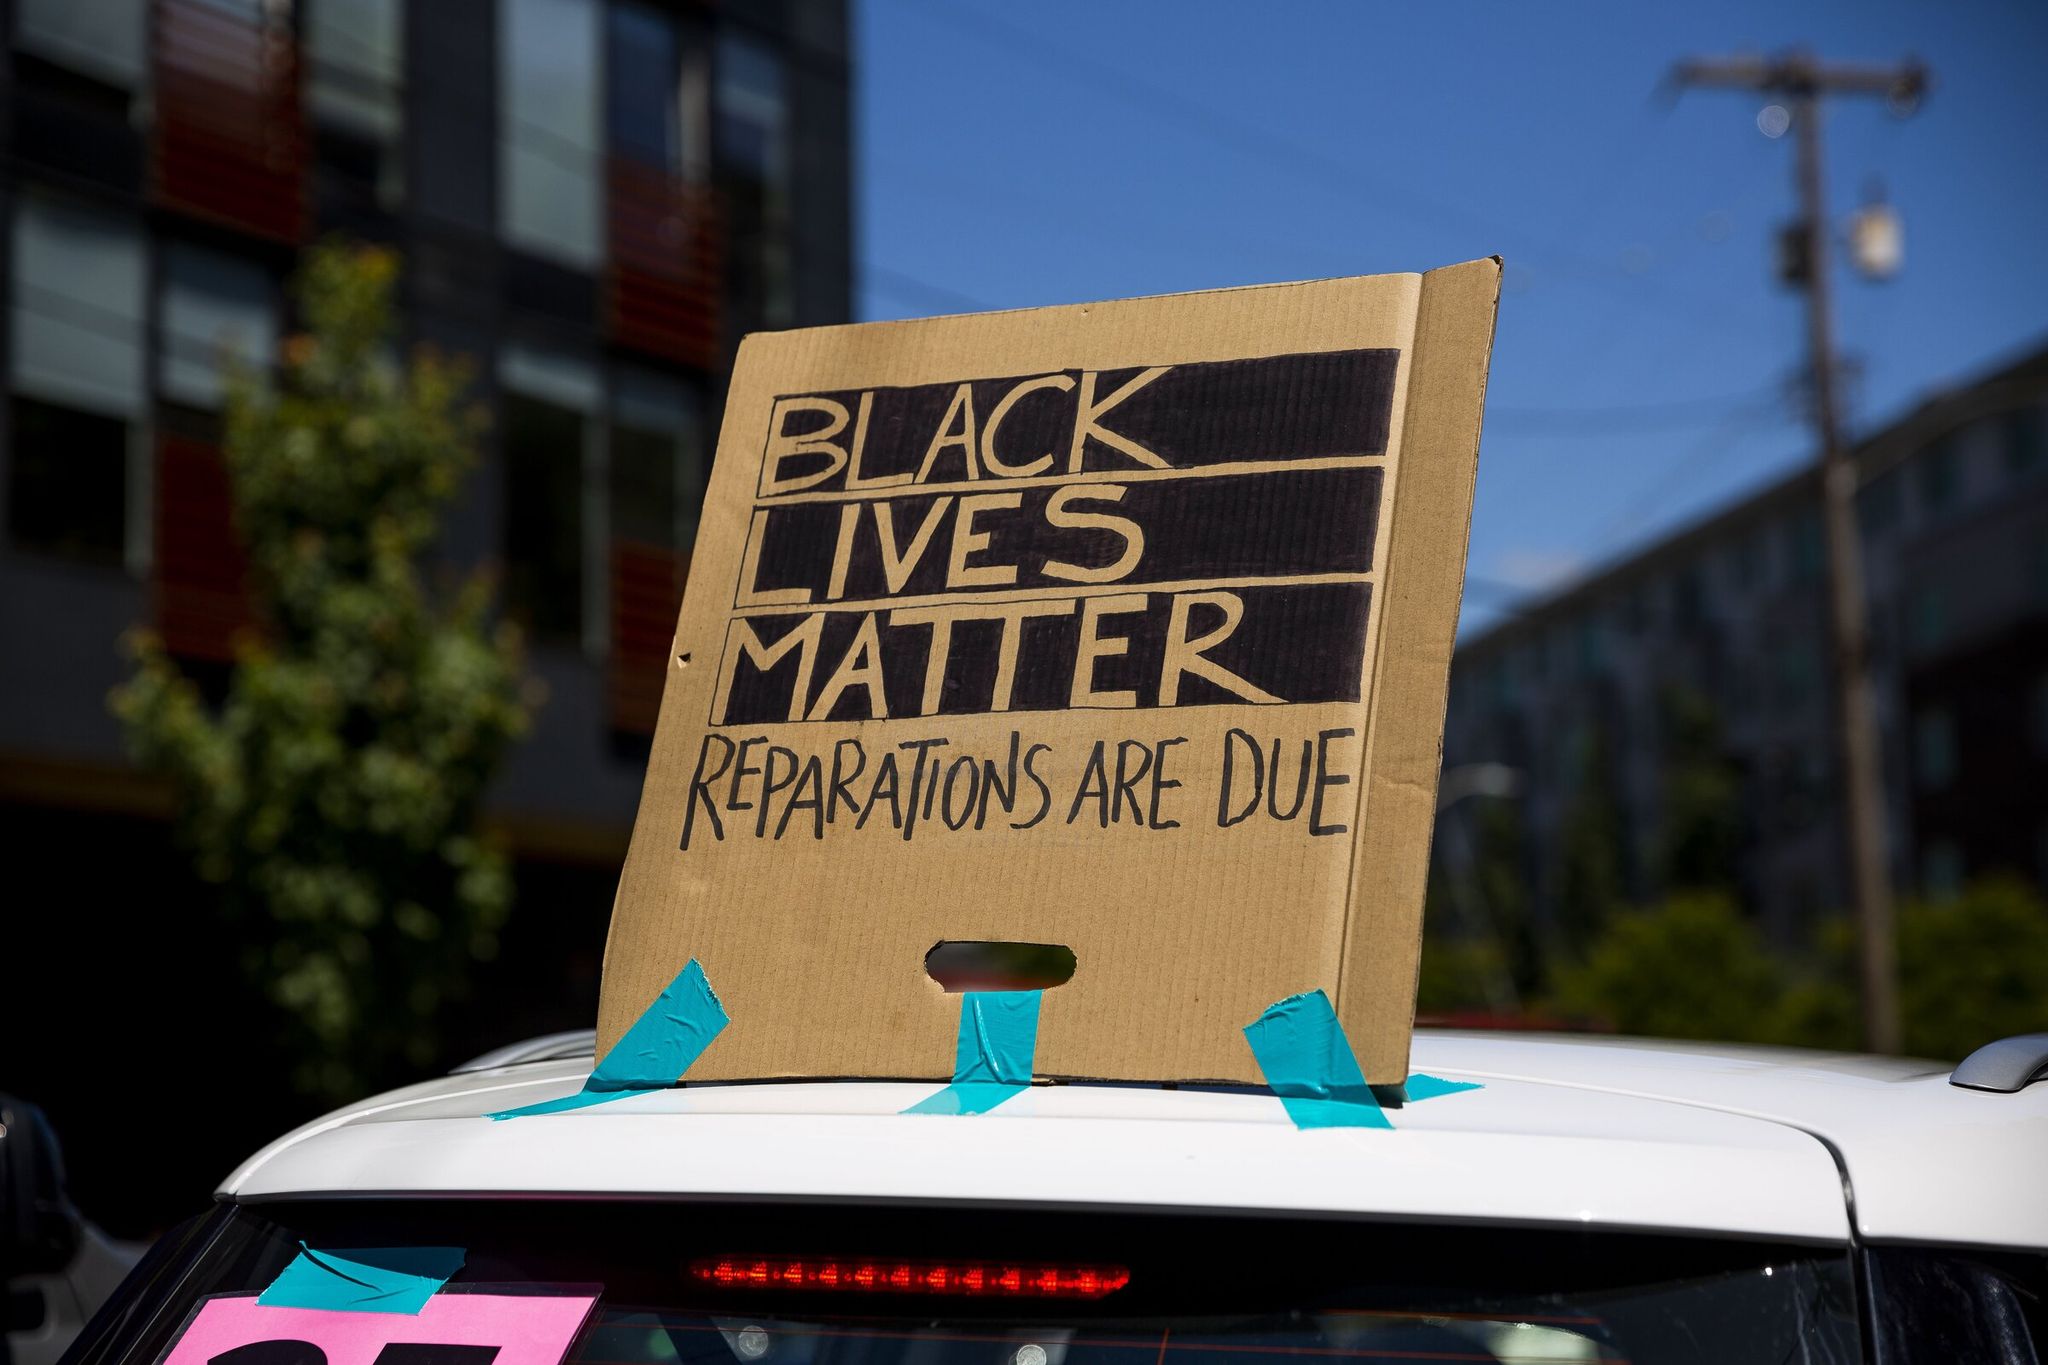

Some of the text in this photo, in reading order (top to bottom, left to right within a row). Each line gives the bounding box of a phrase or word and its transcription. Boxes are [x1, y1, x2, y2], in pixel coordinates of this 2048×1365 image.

[758, 367, 1172, 497] BLACK
[736, 485, 1145, 606] LIVES
[710, 592, 1288, 726] MATTER
[680, 728, 1355, 850] REPARATIONS ARE DUE
